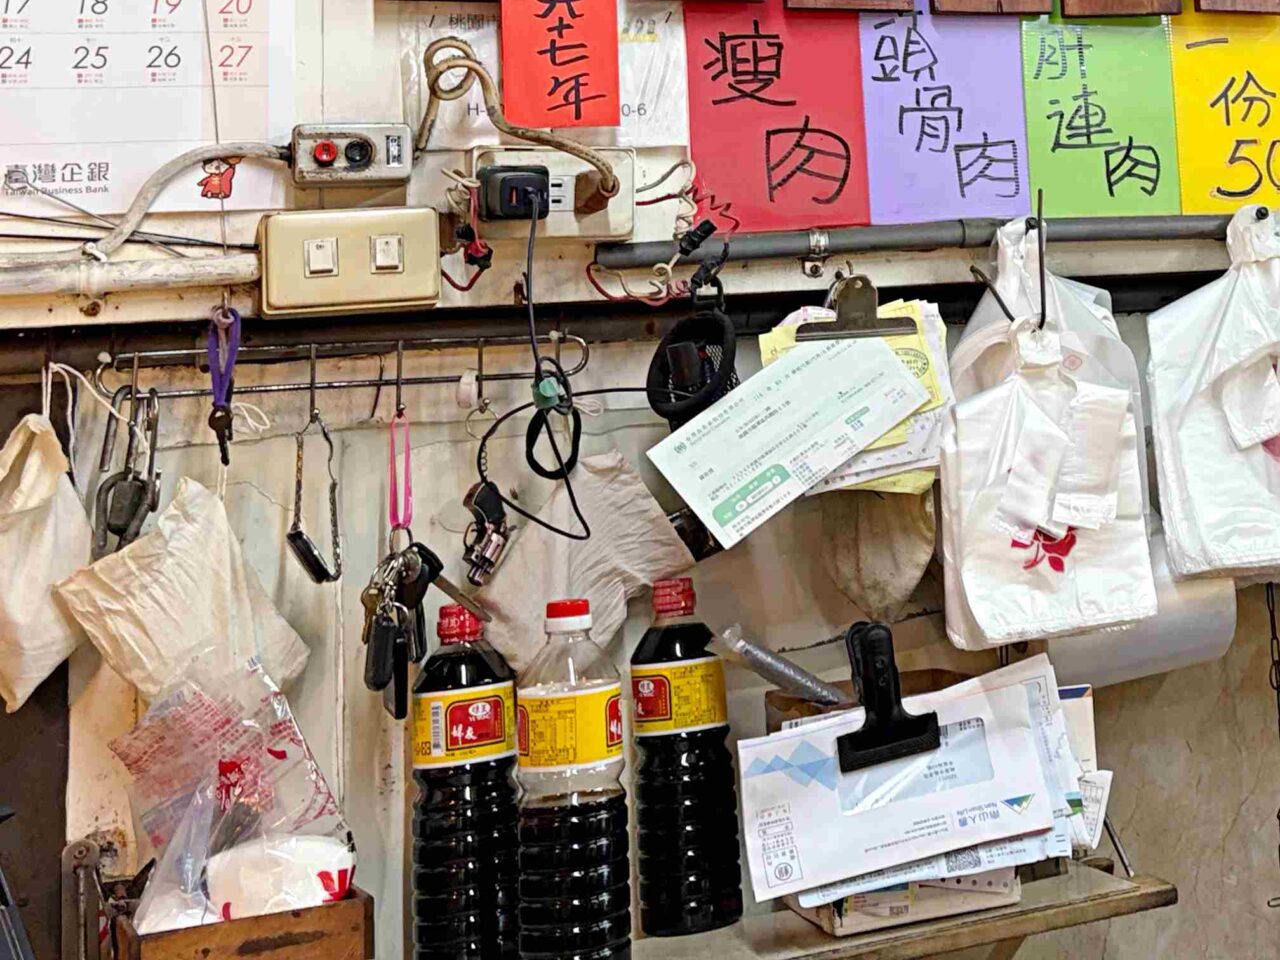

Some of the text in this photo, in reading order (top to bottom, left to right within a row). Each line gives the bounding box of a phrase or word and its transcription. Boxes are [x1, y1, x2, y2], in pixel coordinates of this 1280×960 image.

[0, 46, 32, 69] 24
[72, 46, 109, 69] 25
[146, 45, 182, 68] 26
[218, 45, 253, 68] 27
[702, 18, 850, 205] 瘦肉
[871, 10, 1020, 198] 頭骨肉
[1032, 24, 1161, 198] 肝連肉
[5, 162, 109, 183] 臺灣企銀
[41, 186, 83, 196] Business
[86, 185, 109, 194] Bank
